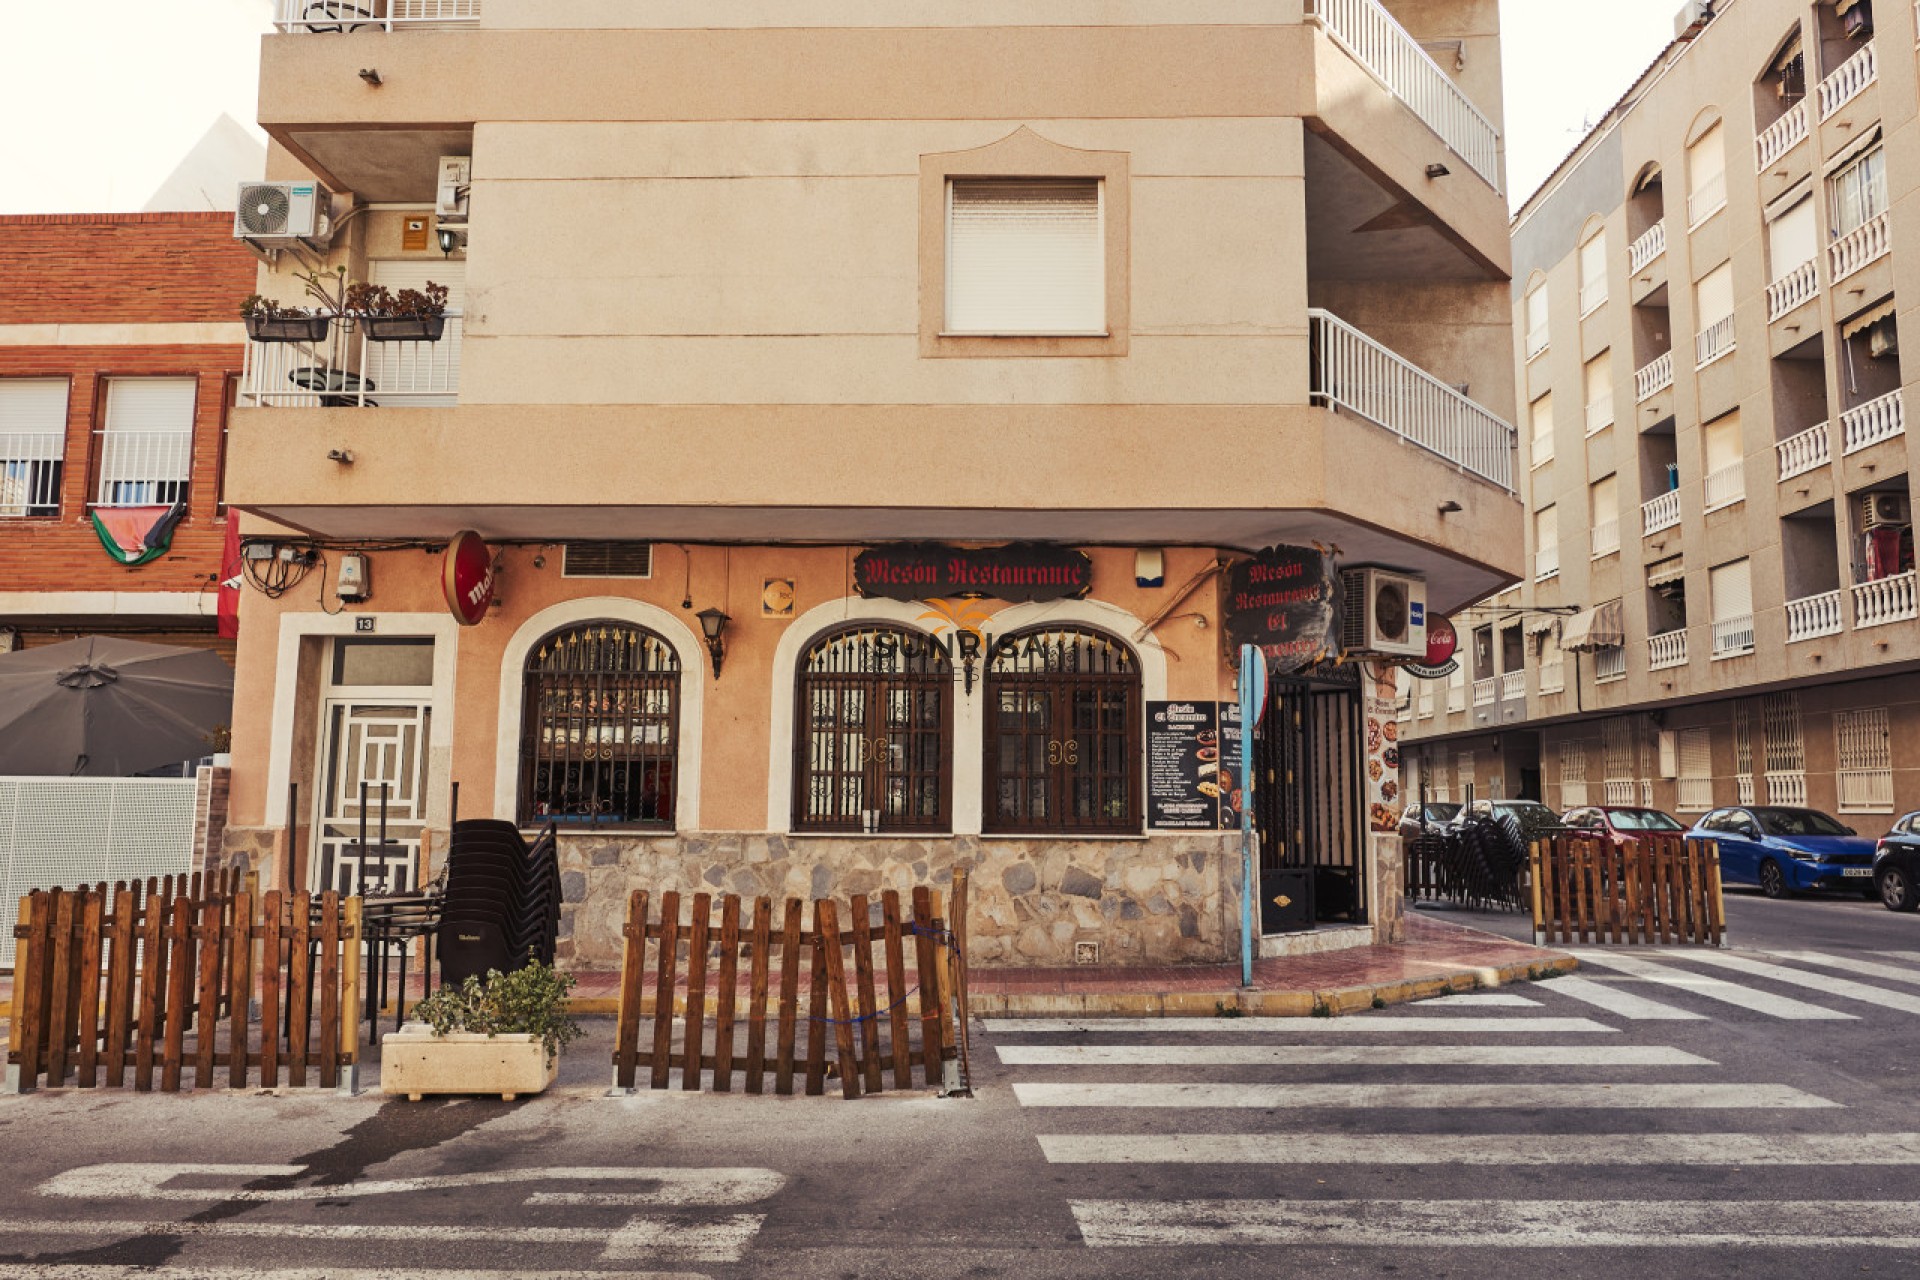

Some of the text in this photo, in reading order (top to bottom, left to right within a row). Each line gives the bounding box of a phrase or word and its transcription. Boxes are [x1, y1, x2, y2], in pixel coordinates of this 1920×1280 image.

[864, 558, 1082, 585] Mesón Restaurante
[1249, 560, 1303, 584] Mesón
[358, 619, 371, 630] 13
[1430, 630, 1451, 645] Cola
